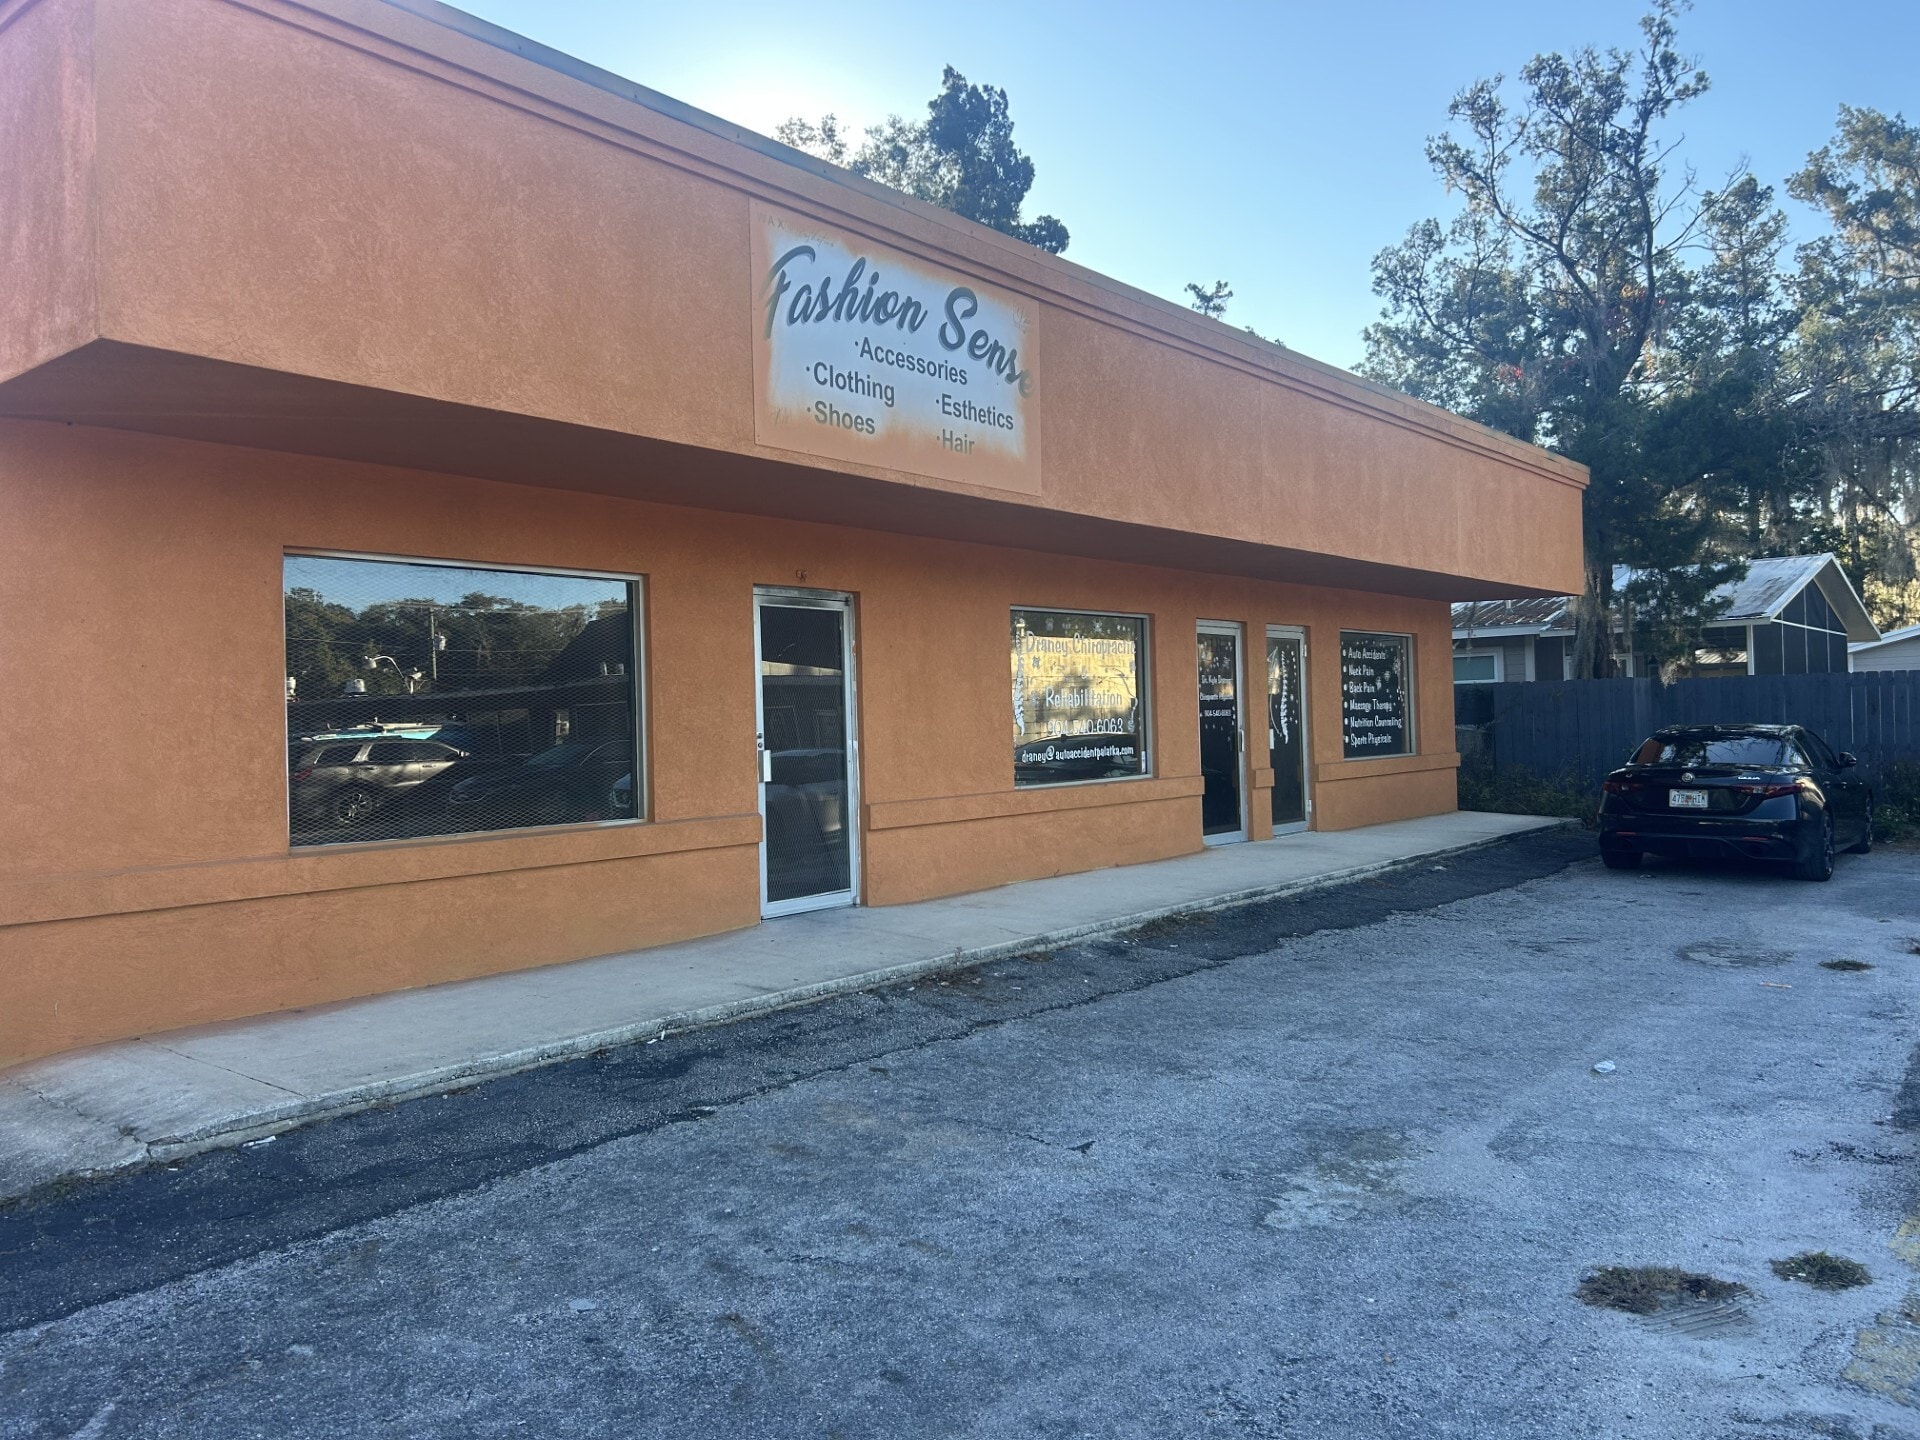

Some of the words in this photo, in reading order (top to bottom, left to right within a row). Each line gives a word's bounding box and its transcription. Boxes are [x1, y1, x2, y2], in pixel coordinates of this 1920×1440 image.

[760, 245, 928, 340] Fashion
[938, 286, 1033, 398] Sense
[860, 336, 968, 385] Accessories
[813, 361, 895, 407] Clothing
[814, 400, 876, 434] Shoes
[941, 393, 1014, 430] Esthetics
[942, 428, 975, 455] Hair
[1026, 630, 1068, 658] Draney
[1072, 633, 1137, 659] Chiropractic
[1348, 647, 1361, 659] Auto
[1362, 648, 1386, 660] Accidents
[1348, 664, 1362, 676] Neck
[1362, 664, 1375, 676] Pain
[1045, 686, 1123, 708] Rehabilitation
[1349, 681, 1363, 693] Back
[1363, 681, 1375, 693] Pain
[1349, 698, 1372, 712] Massage
[1372, 698, 1392, 712] Therapy
[1350, 716, 1374, 728] Nutrition
[1350, 733, 1367, 748] Sports
